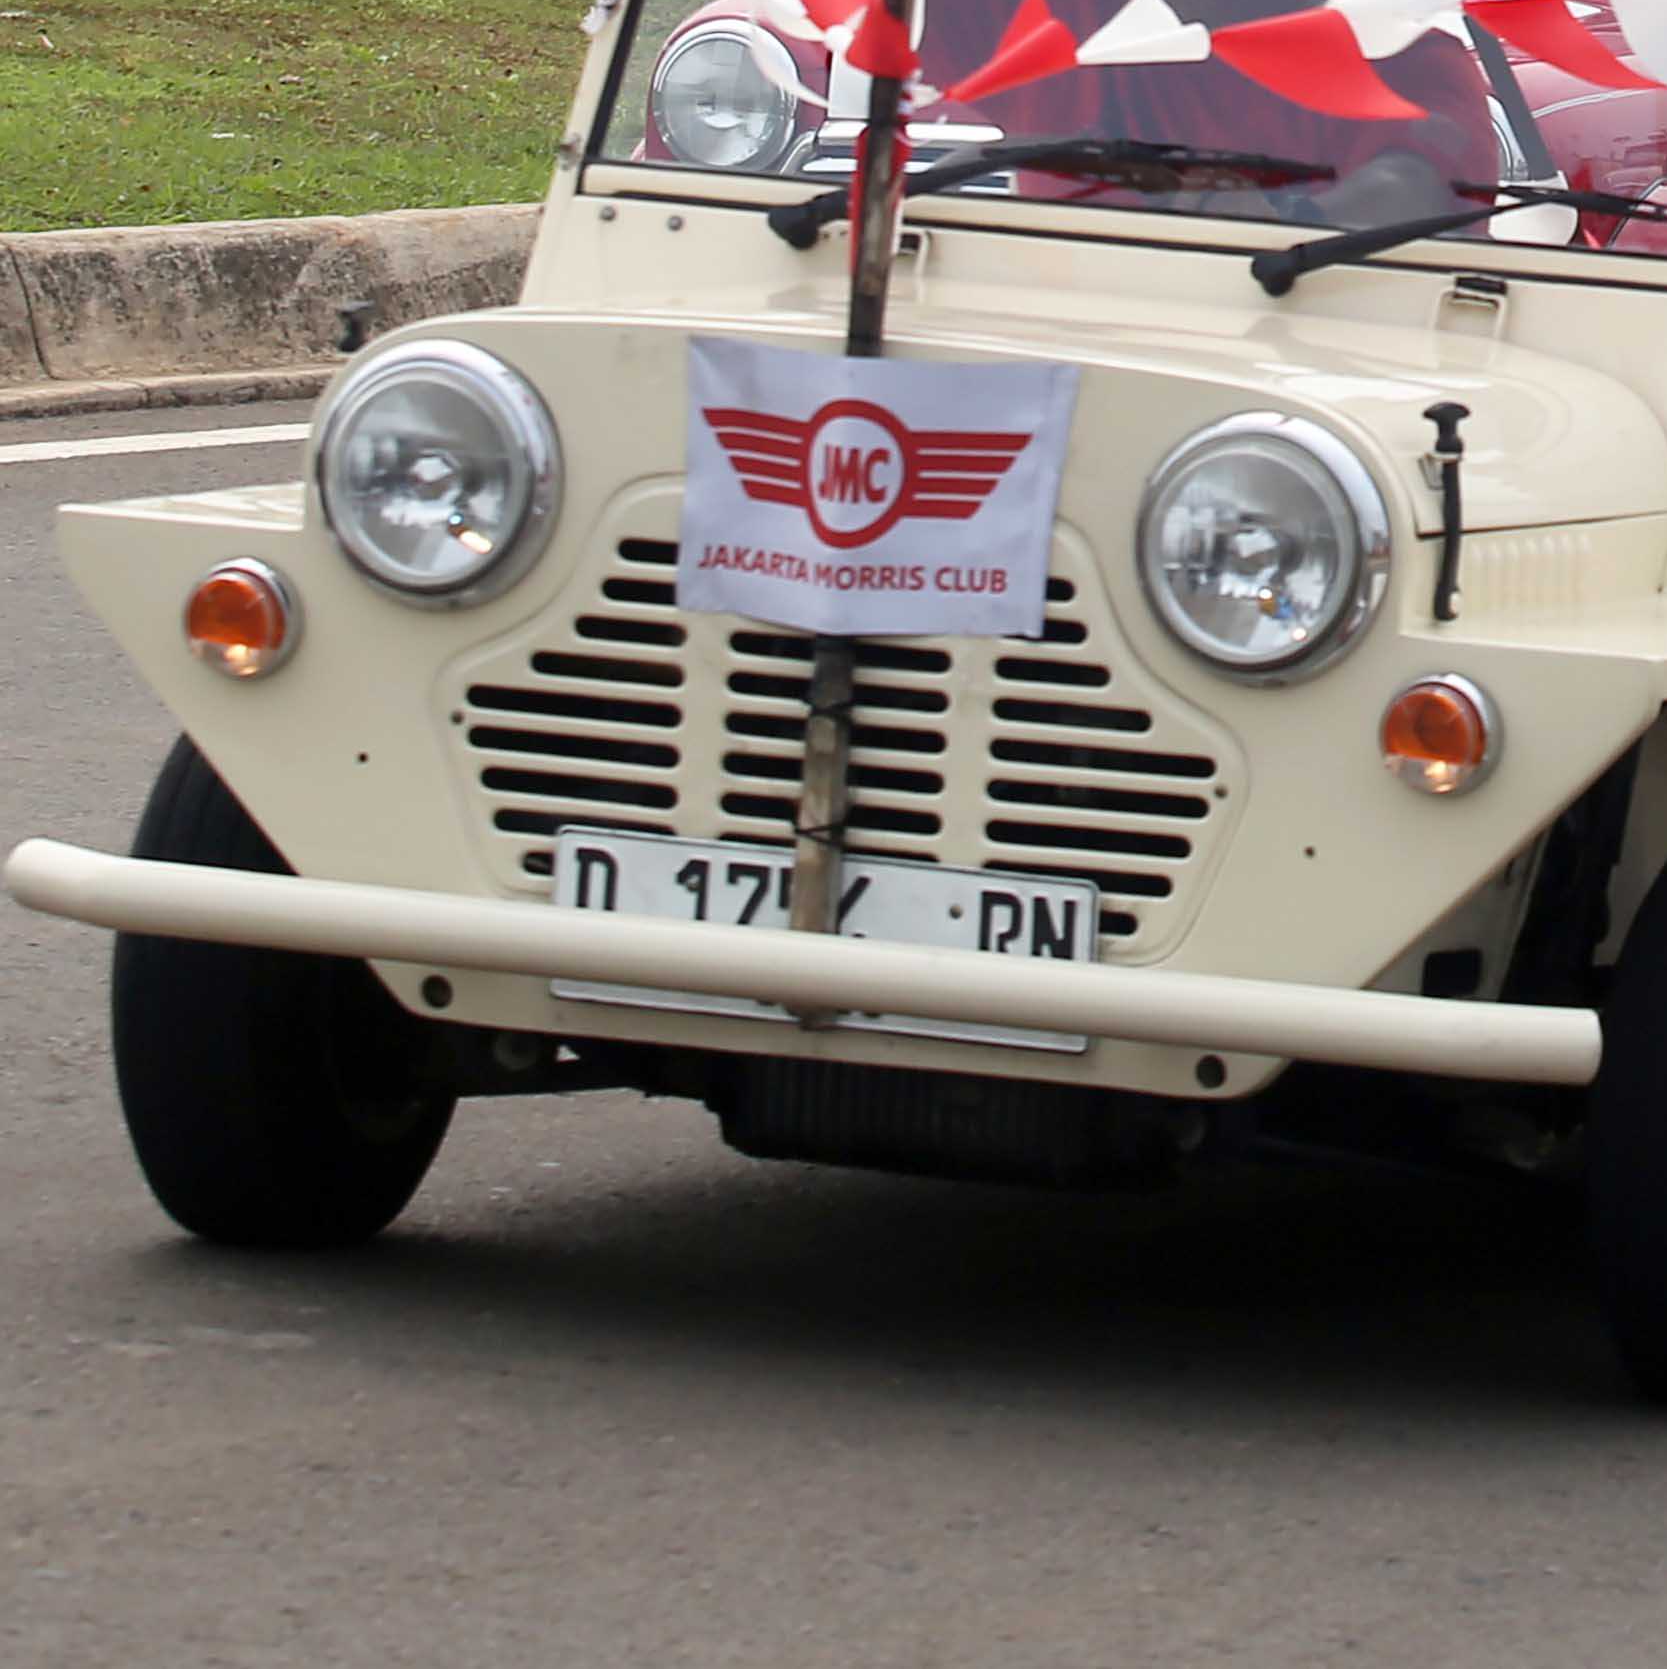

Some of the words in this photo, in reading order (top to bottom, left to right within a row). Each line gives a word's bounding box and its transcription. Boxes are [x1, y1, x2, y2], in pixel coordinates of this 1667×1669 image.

[818, 444, 891, 505] JMC
[698, 543, 808, 582] JAKARTA
[815, 562, 924, 591] MORRIS
[934, 567, 1008, 594] CLUB
[575, 846, 617, 912] D
